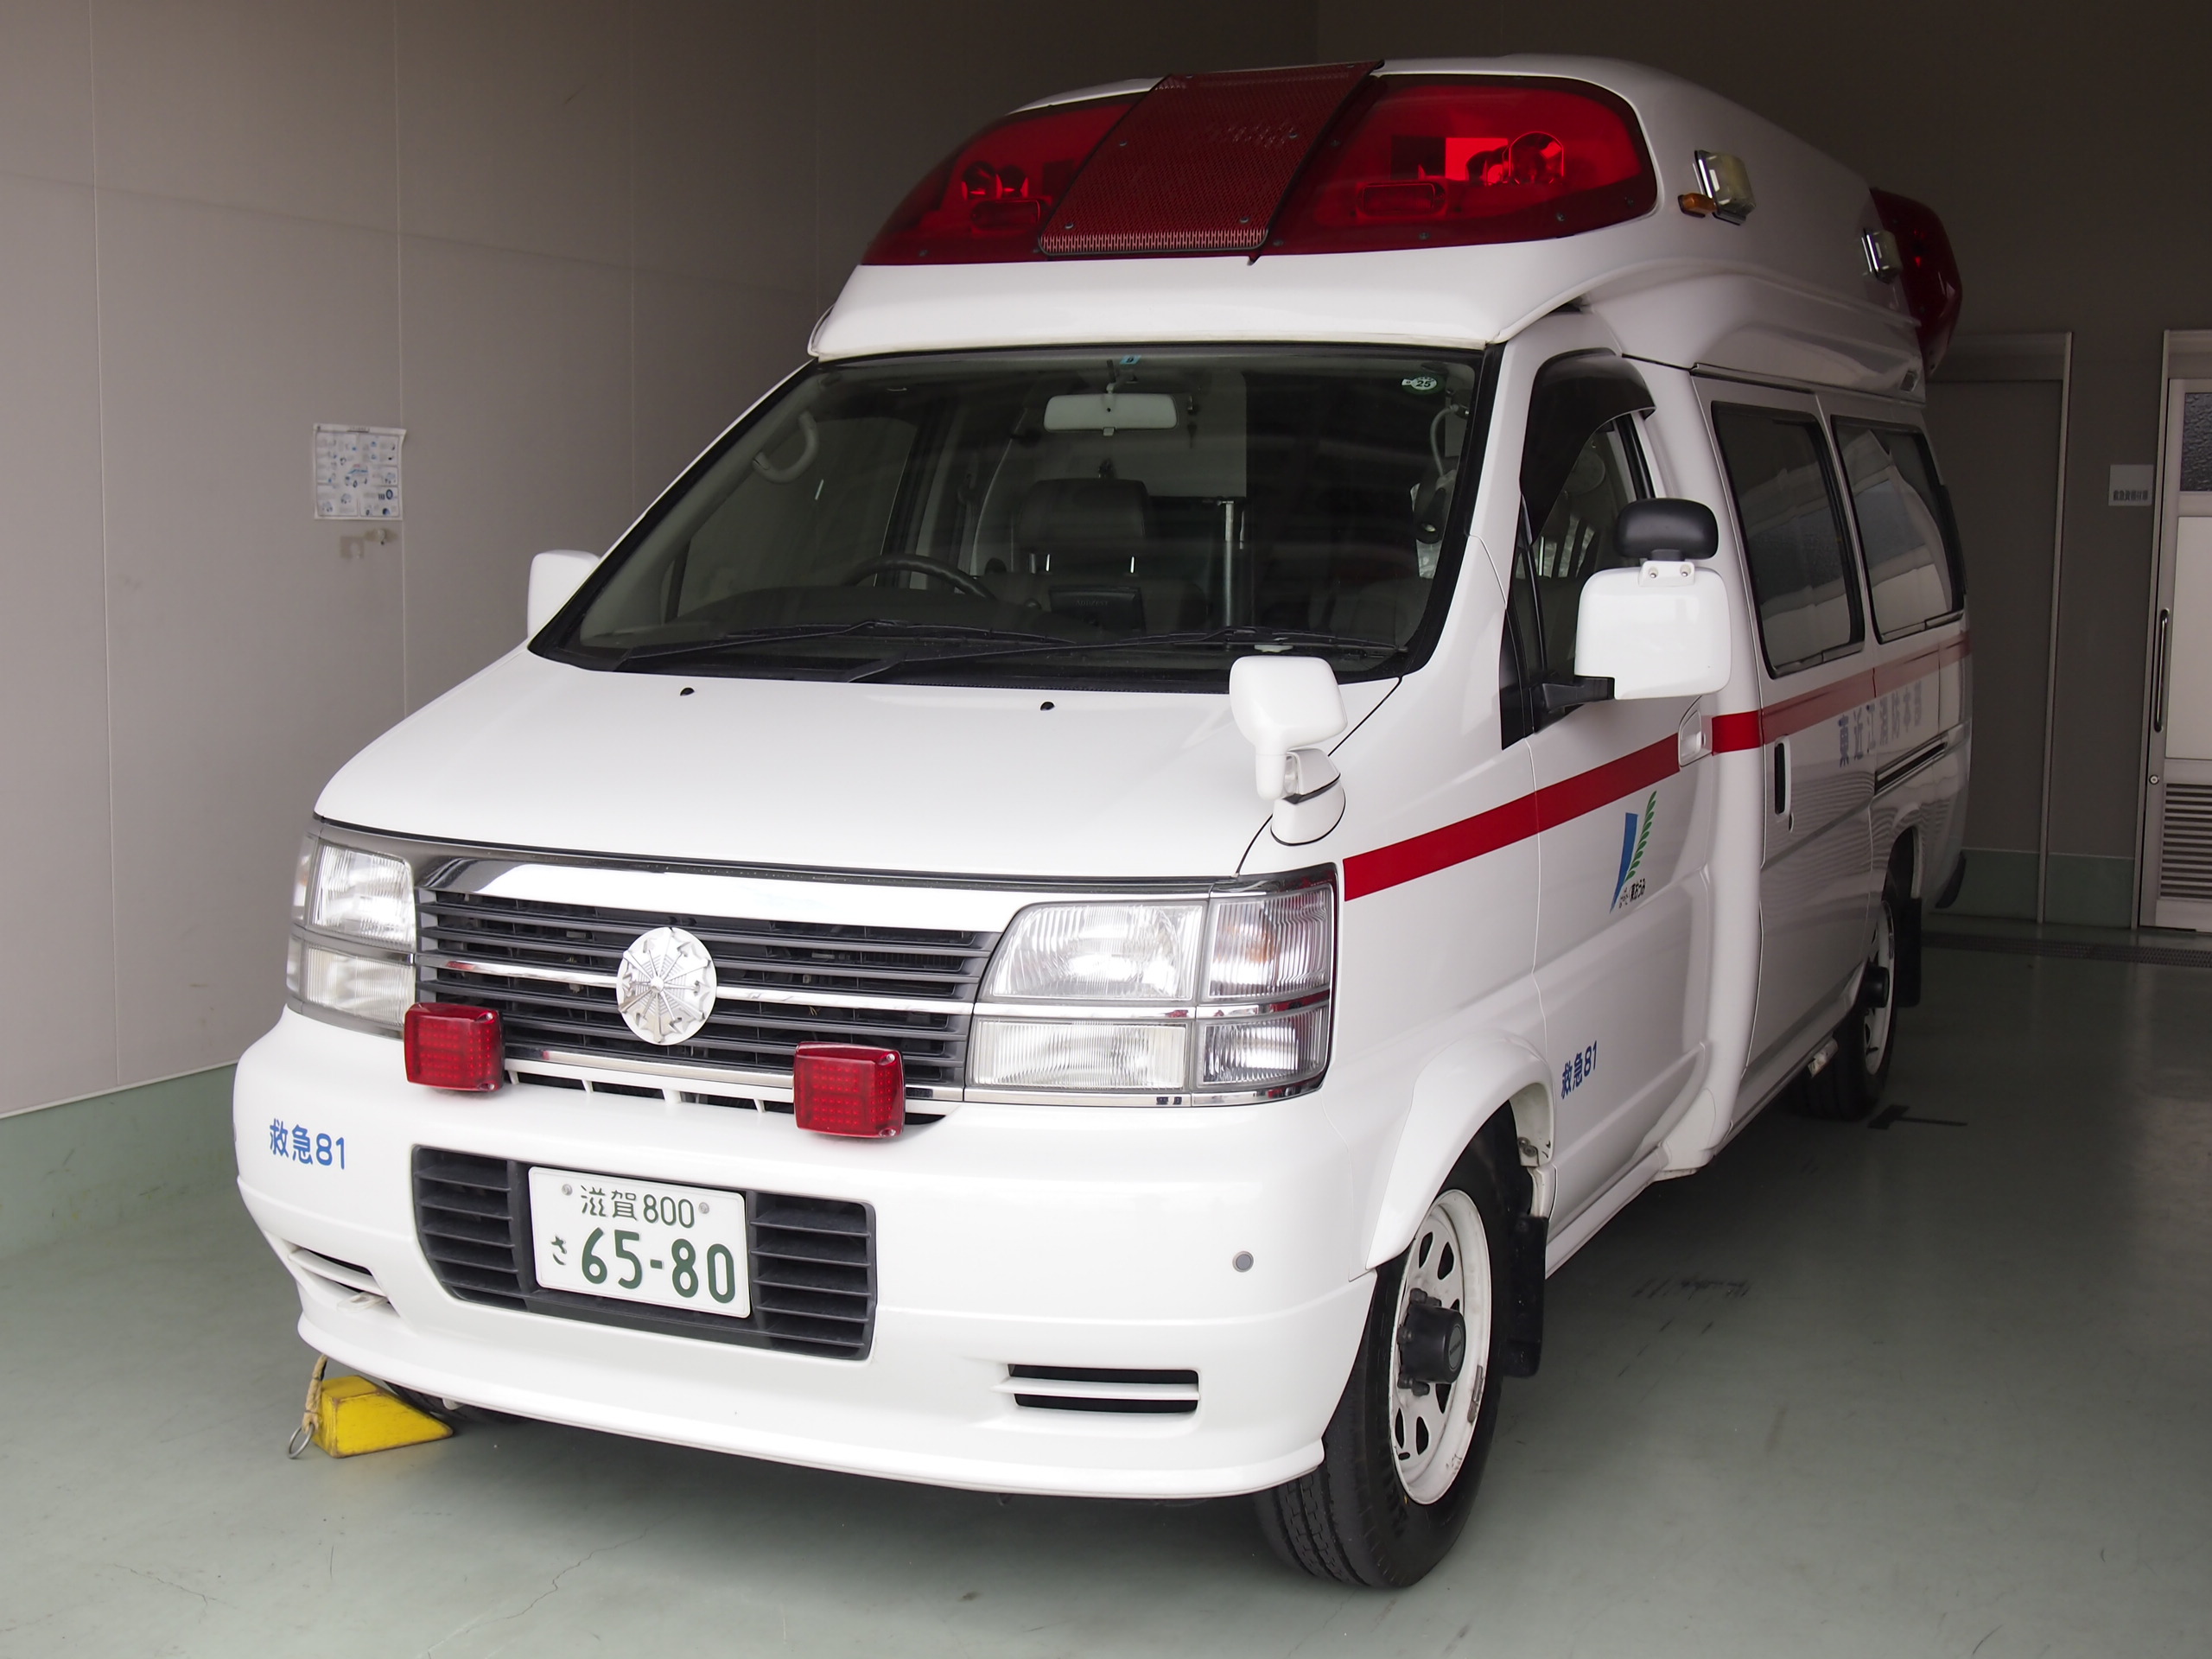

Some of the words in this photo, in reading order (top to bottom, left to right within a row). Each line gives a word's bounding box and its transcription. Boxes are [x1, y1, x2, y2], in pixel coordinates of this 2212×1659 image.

[1561, 1040, 1597, 1100] 救急81
[270, 1118, 345, 1170] 救急81
[581, 1185, 696, 1229] 滋賀800
[550, 1235, 567, 1266] さ
[581, 1227, 735, 1304] 65-80
